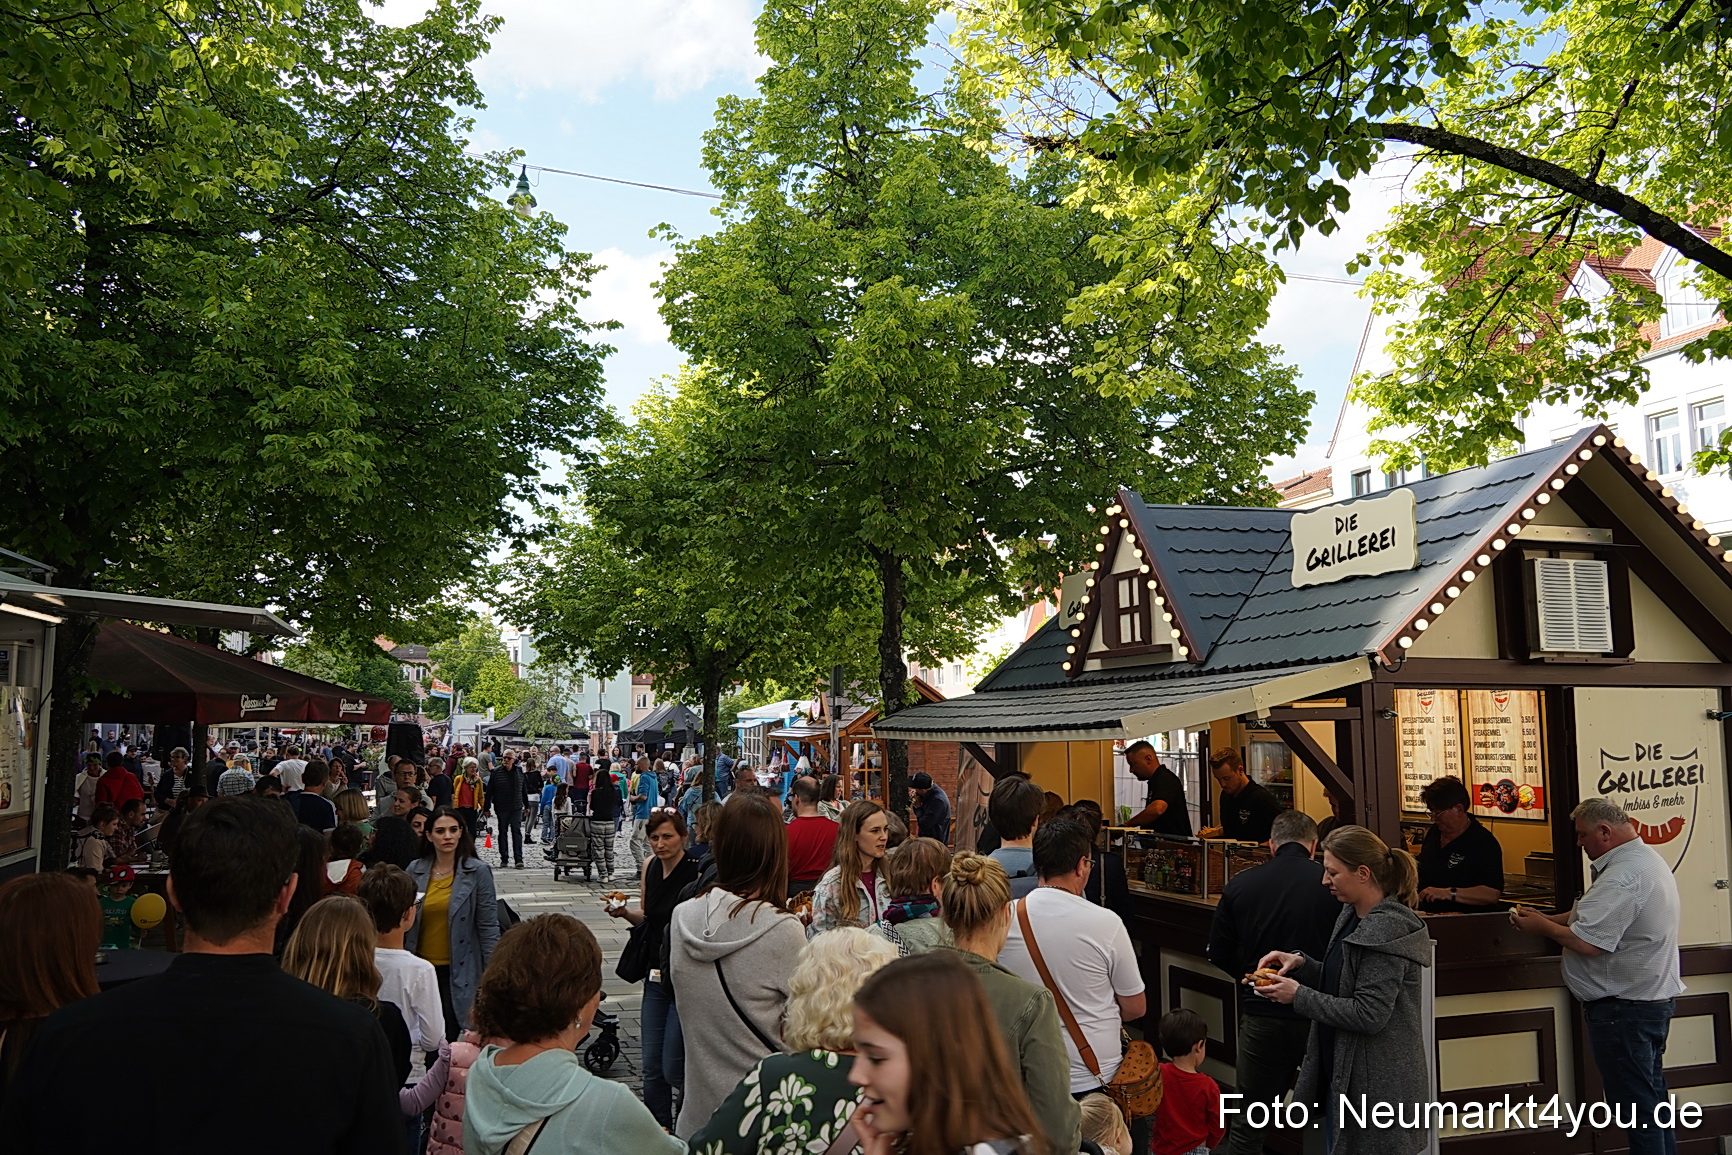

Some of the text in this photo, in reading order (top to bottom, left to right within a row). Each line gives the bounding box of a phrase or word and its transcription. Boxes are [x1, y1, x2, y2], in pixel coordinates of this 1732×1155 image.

[1335, 513, 1358, 535] DIE
[1306, 526, 1396, 571] GRILLEREI
[1635, 742, 1663, 762] DIE
[1598, 764, 1704, 794] GRILLEREI
[1623, 792, 1686, 811] Imbiss & mehr
